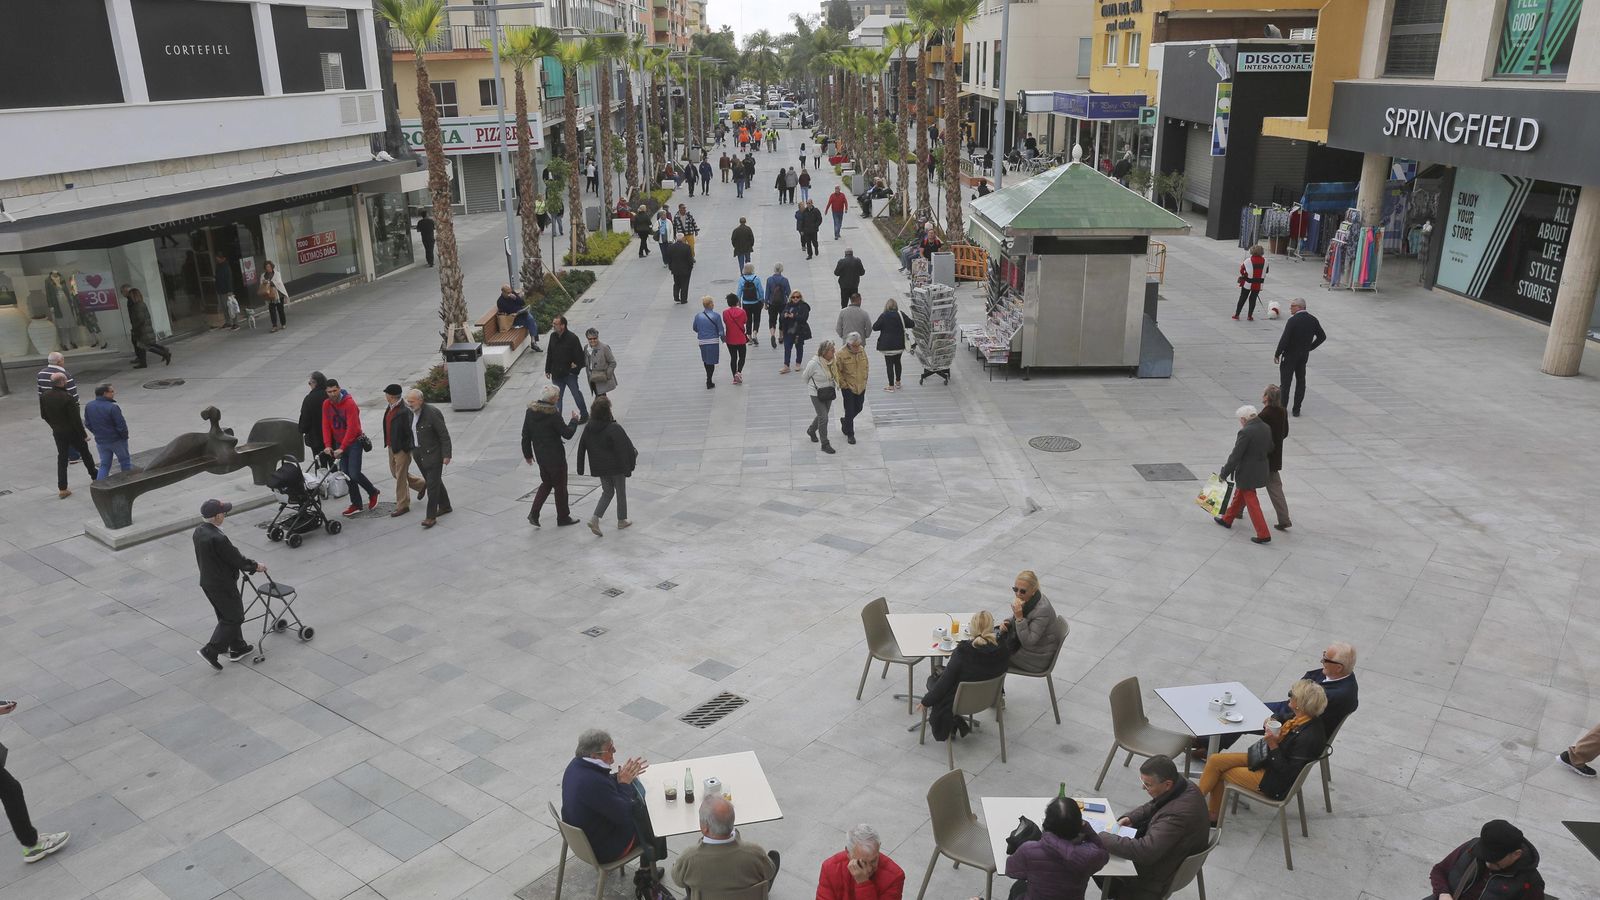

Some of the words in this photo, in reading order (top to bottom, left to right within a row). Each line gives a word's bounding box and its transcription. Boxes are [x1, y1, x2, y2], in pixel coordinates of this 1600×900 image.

[1512, 13, 1537, 31] GOOD
[165, 45, 231, 55] CORTEFIEL
[1245, 54, 1314, 64] DISCOTE
[1383, 107, 1539, 151] SPRINGFIELD
[1458, 192, 1479, 208] ENJOY
[1558, 187, 1576, 205] IT'S
[1457, 208, 1475, 224] YOUR
[1553, 206, 1570, 224] ALL
[1452, 224, 1473, 241] STORE
[1537, 222, 1568, 242] ABOUT
[323, 245, 336, 256] DÍAS
[1517, 279, 1552, 304] STORIES.
